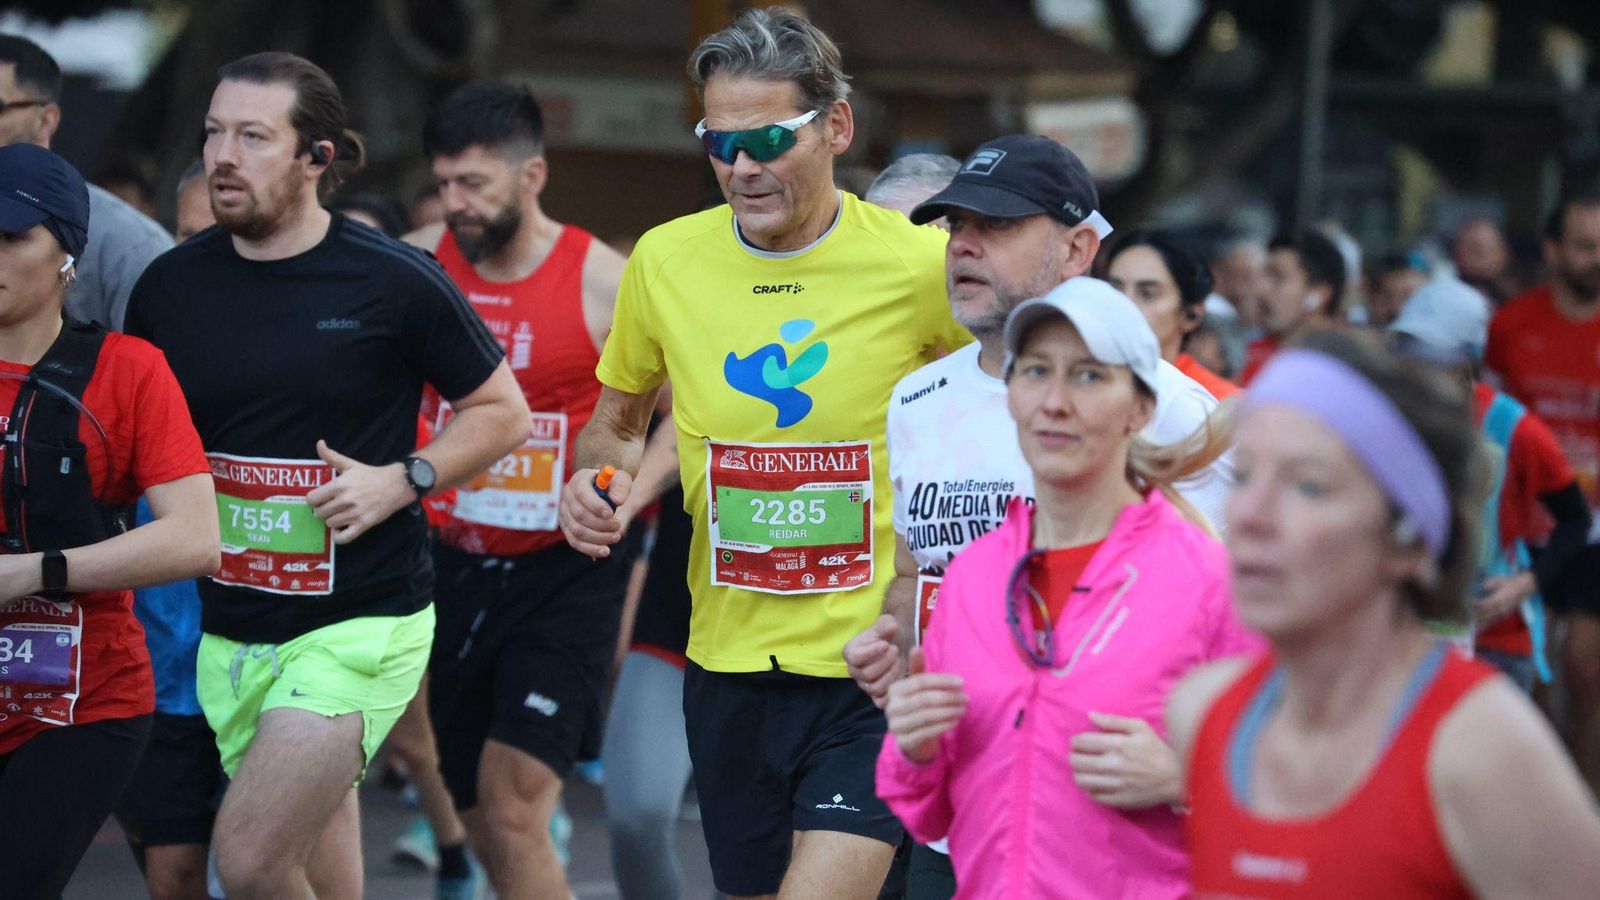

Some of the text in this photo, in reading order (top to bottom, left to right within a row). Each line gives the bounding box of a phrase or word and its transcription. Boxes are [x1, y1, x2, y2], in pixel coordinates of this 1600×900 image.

[1063, 201, 1082, 218] FILA
[752, 284, 794, 294] CRAFT
[316, 318, 360, 329] adidas
[901, 381, 935, 406] luanvi
[750, 451, 860, 473] GENERALI
[229, 464, 322, 487] GENERALI
[943, 479, 1015, 495] TotalEnergies
[750, 498, 827, 525] 2285
[908, 482, 938, 522] 40
[937, 494, 990, 519] MEDIA
[228, 504, 291, 533] 7554
[769, 529, 807, 539] REIDAR
[907, 521, 964, 551] CIUDAD
[282, 562, 310, 572] 42K
[818, 555, 848, 566] 42K
[815, 803, 861, 812] RONHILL
